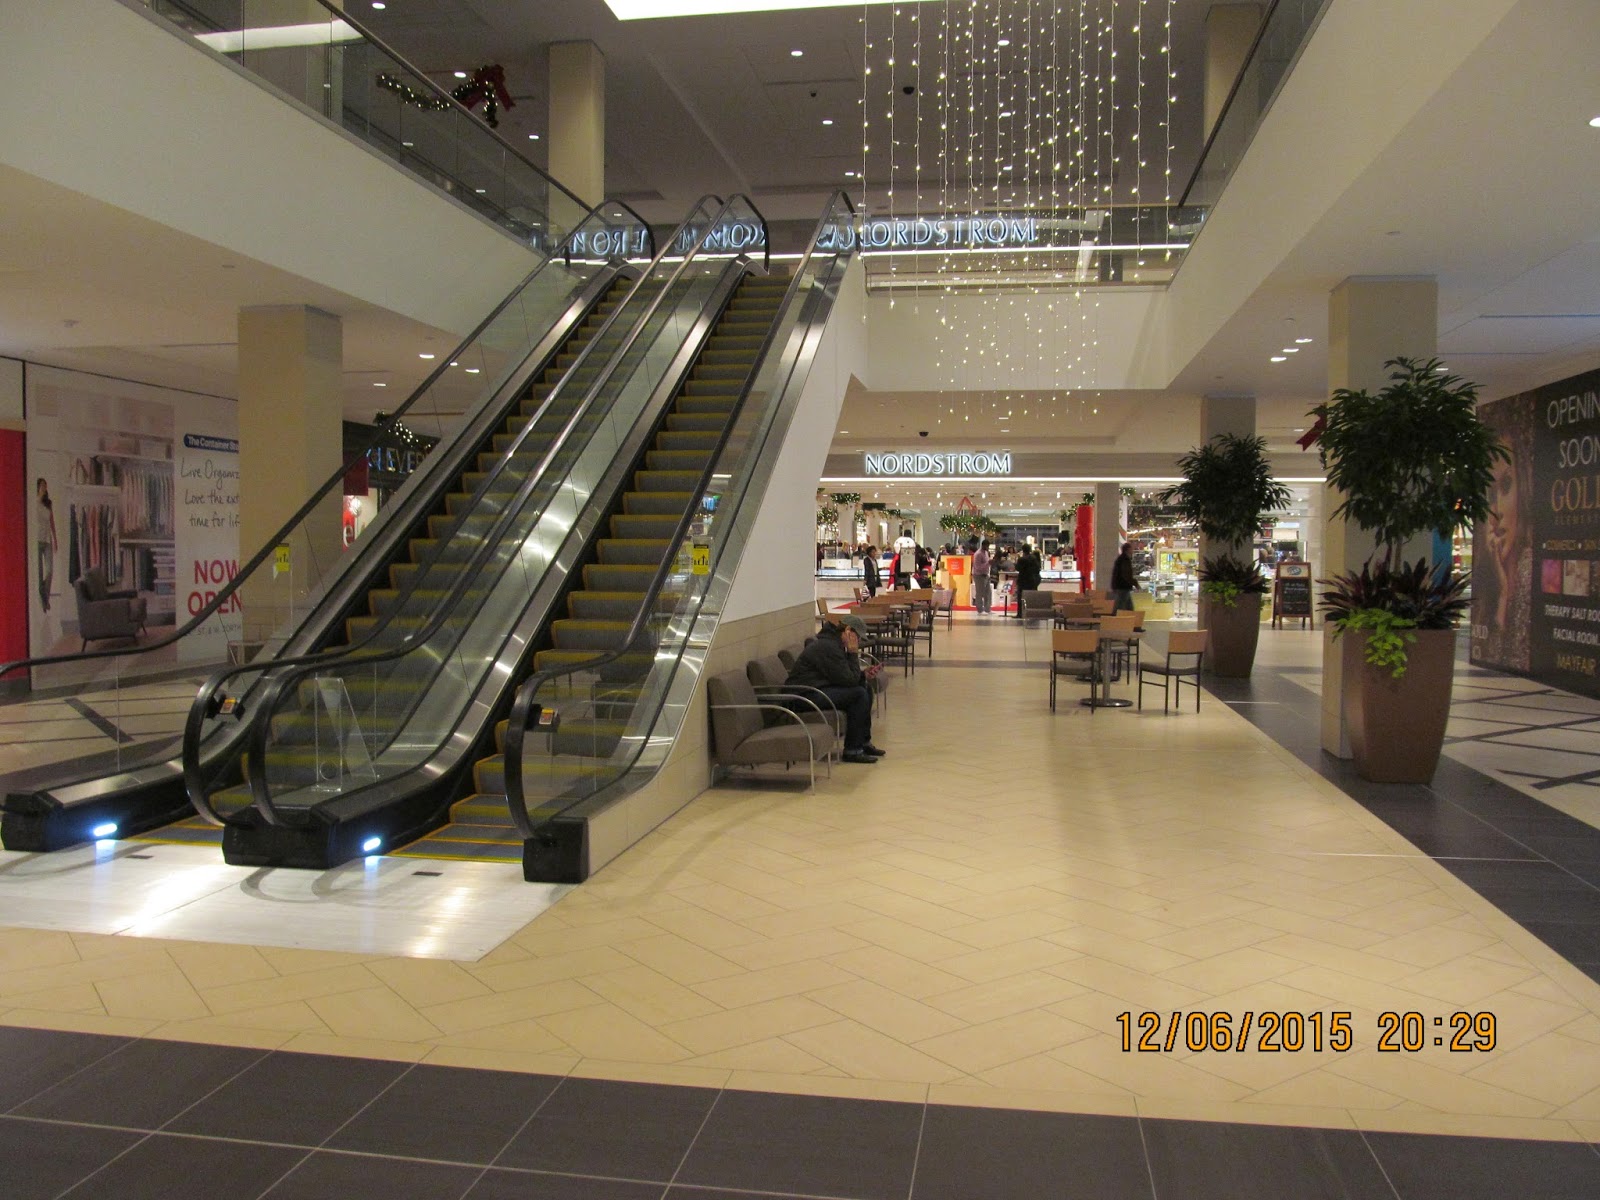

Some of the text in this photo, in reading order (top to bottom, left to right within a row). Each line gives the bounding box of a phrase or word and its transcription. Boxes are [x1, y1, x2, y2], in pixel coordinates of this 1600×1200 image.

[188, 435, 199, 446] The
[200, 437, 229, 450] Container
[181, 457, 202, 478] Live
[865, 453, 1011, 474] NORDSTROM
[185, 489, 205, 505] Love
[208, 489, 224, 504] the
[189, 513, 209, 528] time
[212, 511, 225, 528] for
[194, 559, 241, 585] NOW
[187, 591, 243, 617] OPEN
[1545, 604, 1571, 618] THERAPY
[1571, 607, 1587, 620] SALT
[1553, 628, 1576, 642] FACIAL
